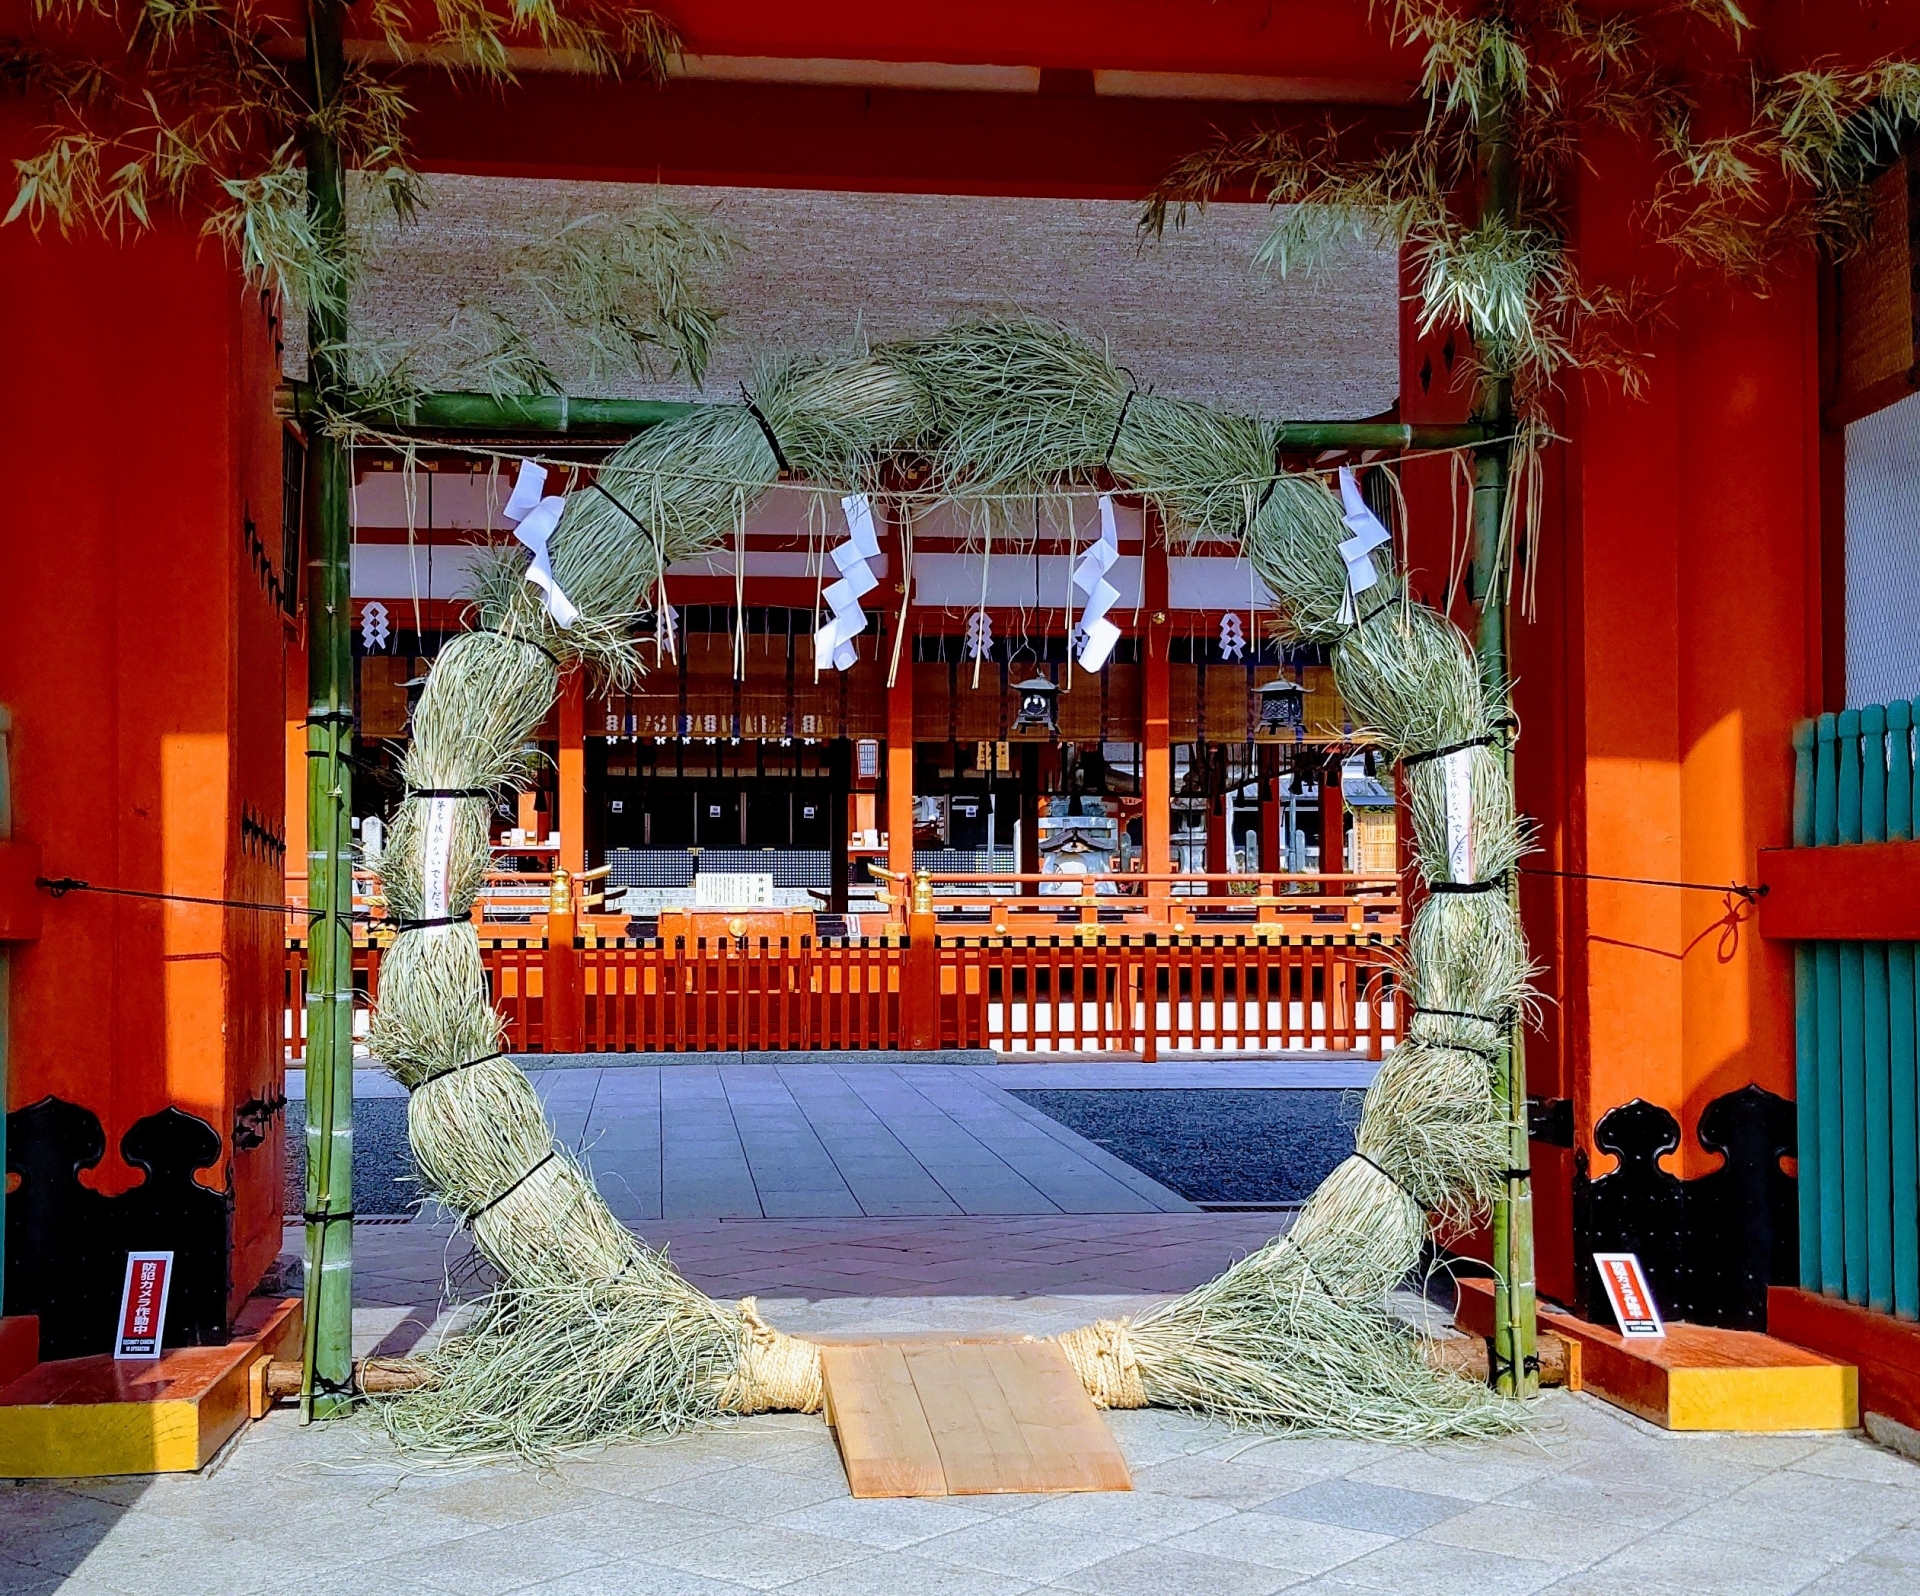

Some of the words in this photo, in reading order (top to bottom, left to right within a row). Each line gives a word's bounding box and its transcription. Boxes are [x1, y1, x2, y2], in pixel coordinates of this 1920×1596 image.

[430, 800, 446, 920] 茅を抜かないでくださ
[133, 1262, 157, 1334] 防犯カメラ作動中
